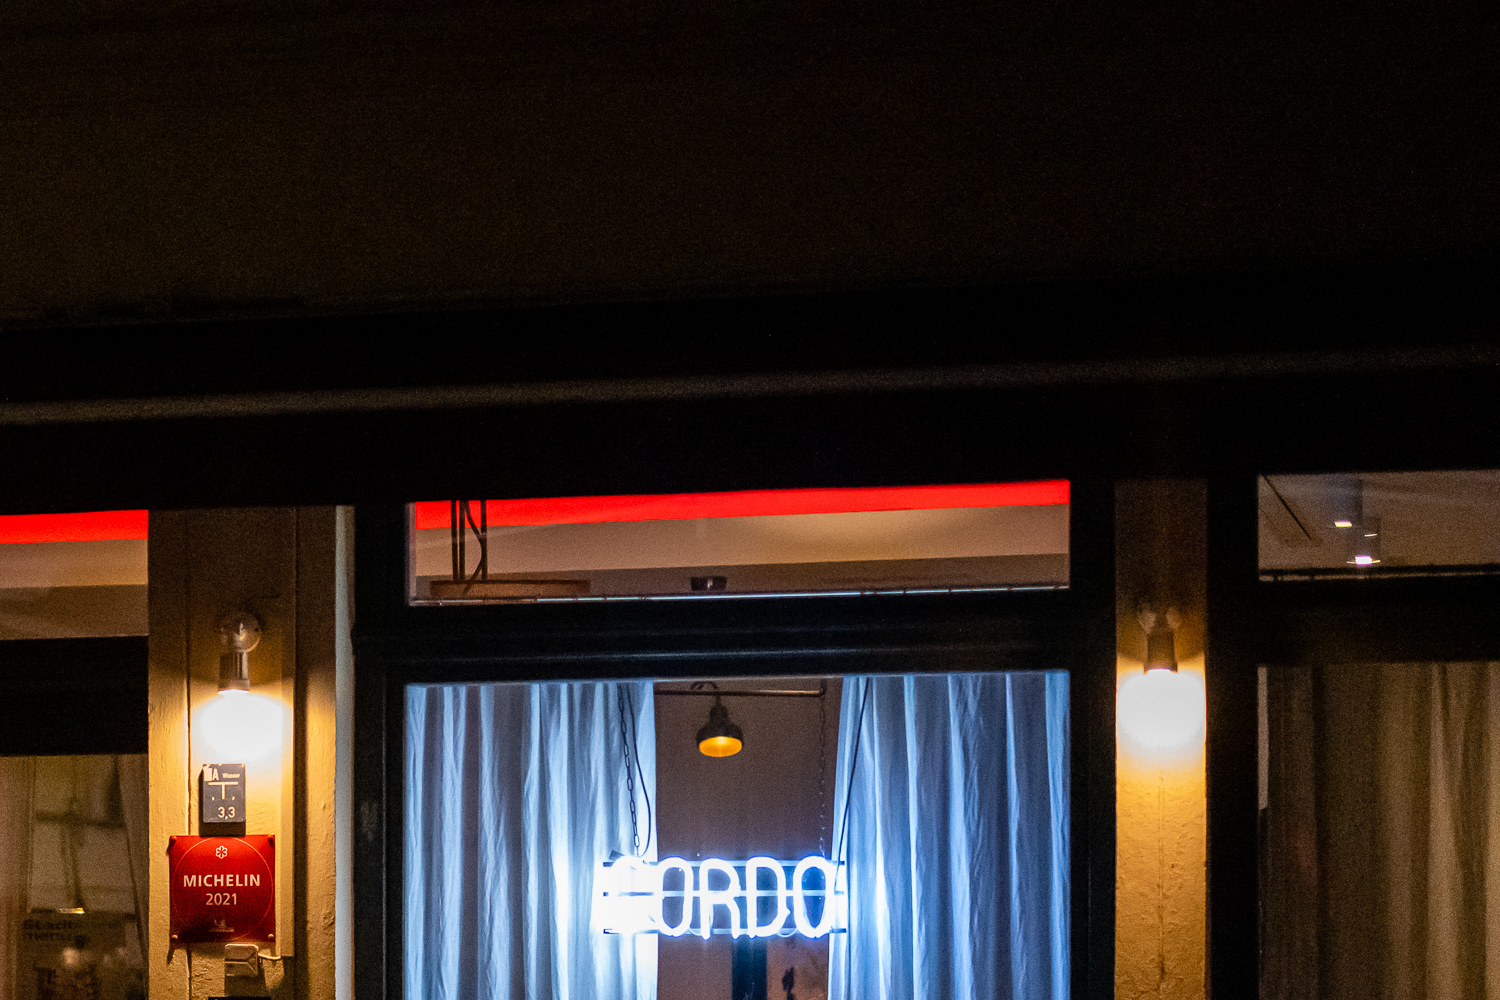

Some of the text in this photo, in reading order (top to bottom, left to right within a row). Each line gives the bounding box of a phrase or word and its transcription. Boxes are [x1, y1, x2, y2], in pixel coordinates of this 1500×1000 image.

[217, 806, 236, 820] 3,3
[183, 874, 261, 887] MICHELIN
[206, 893, 238, 906] 2021
[610, 855, 834, 939] ORDO
